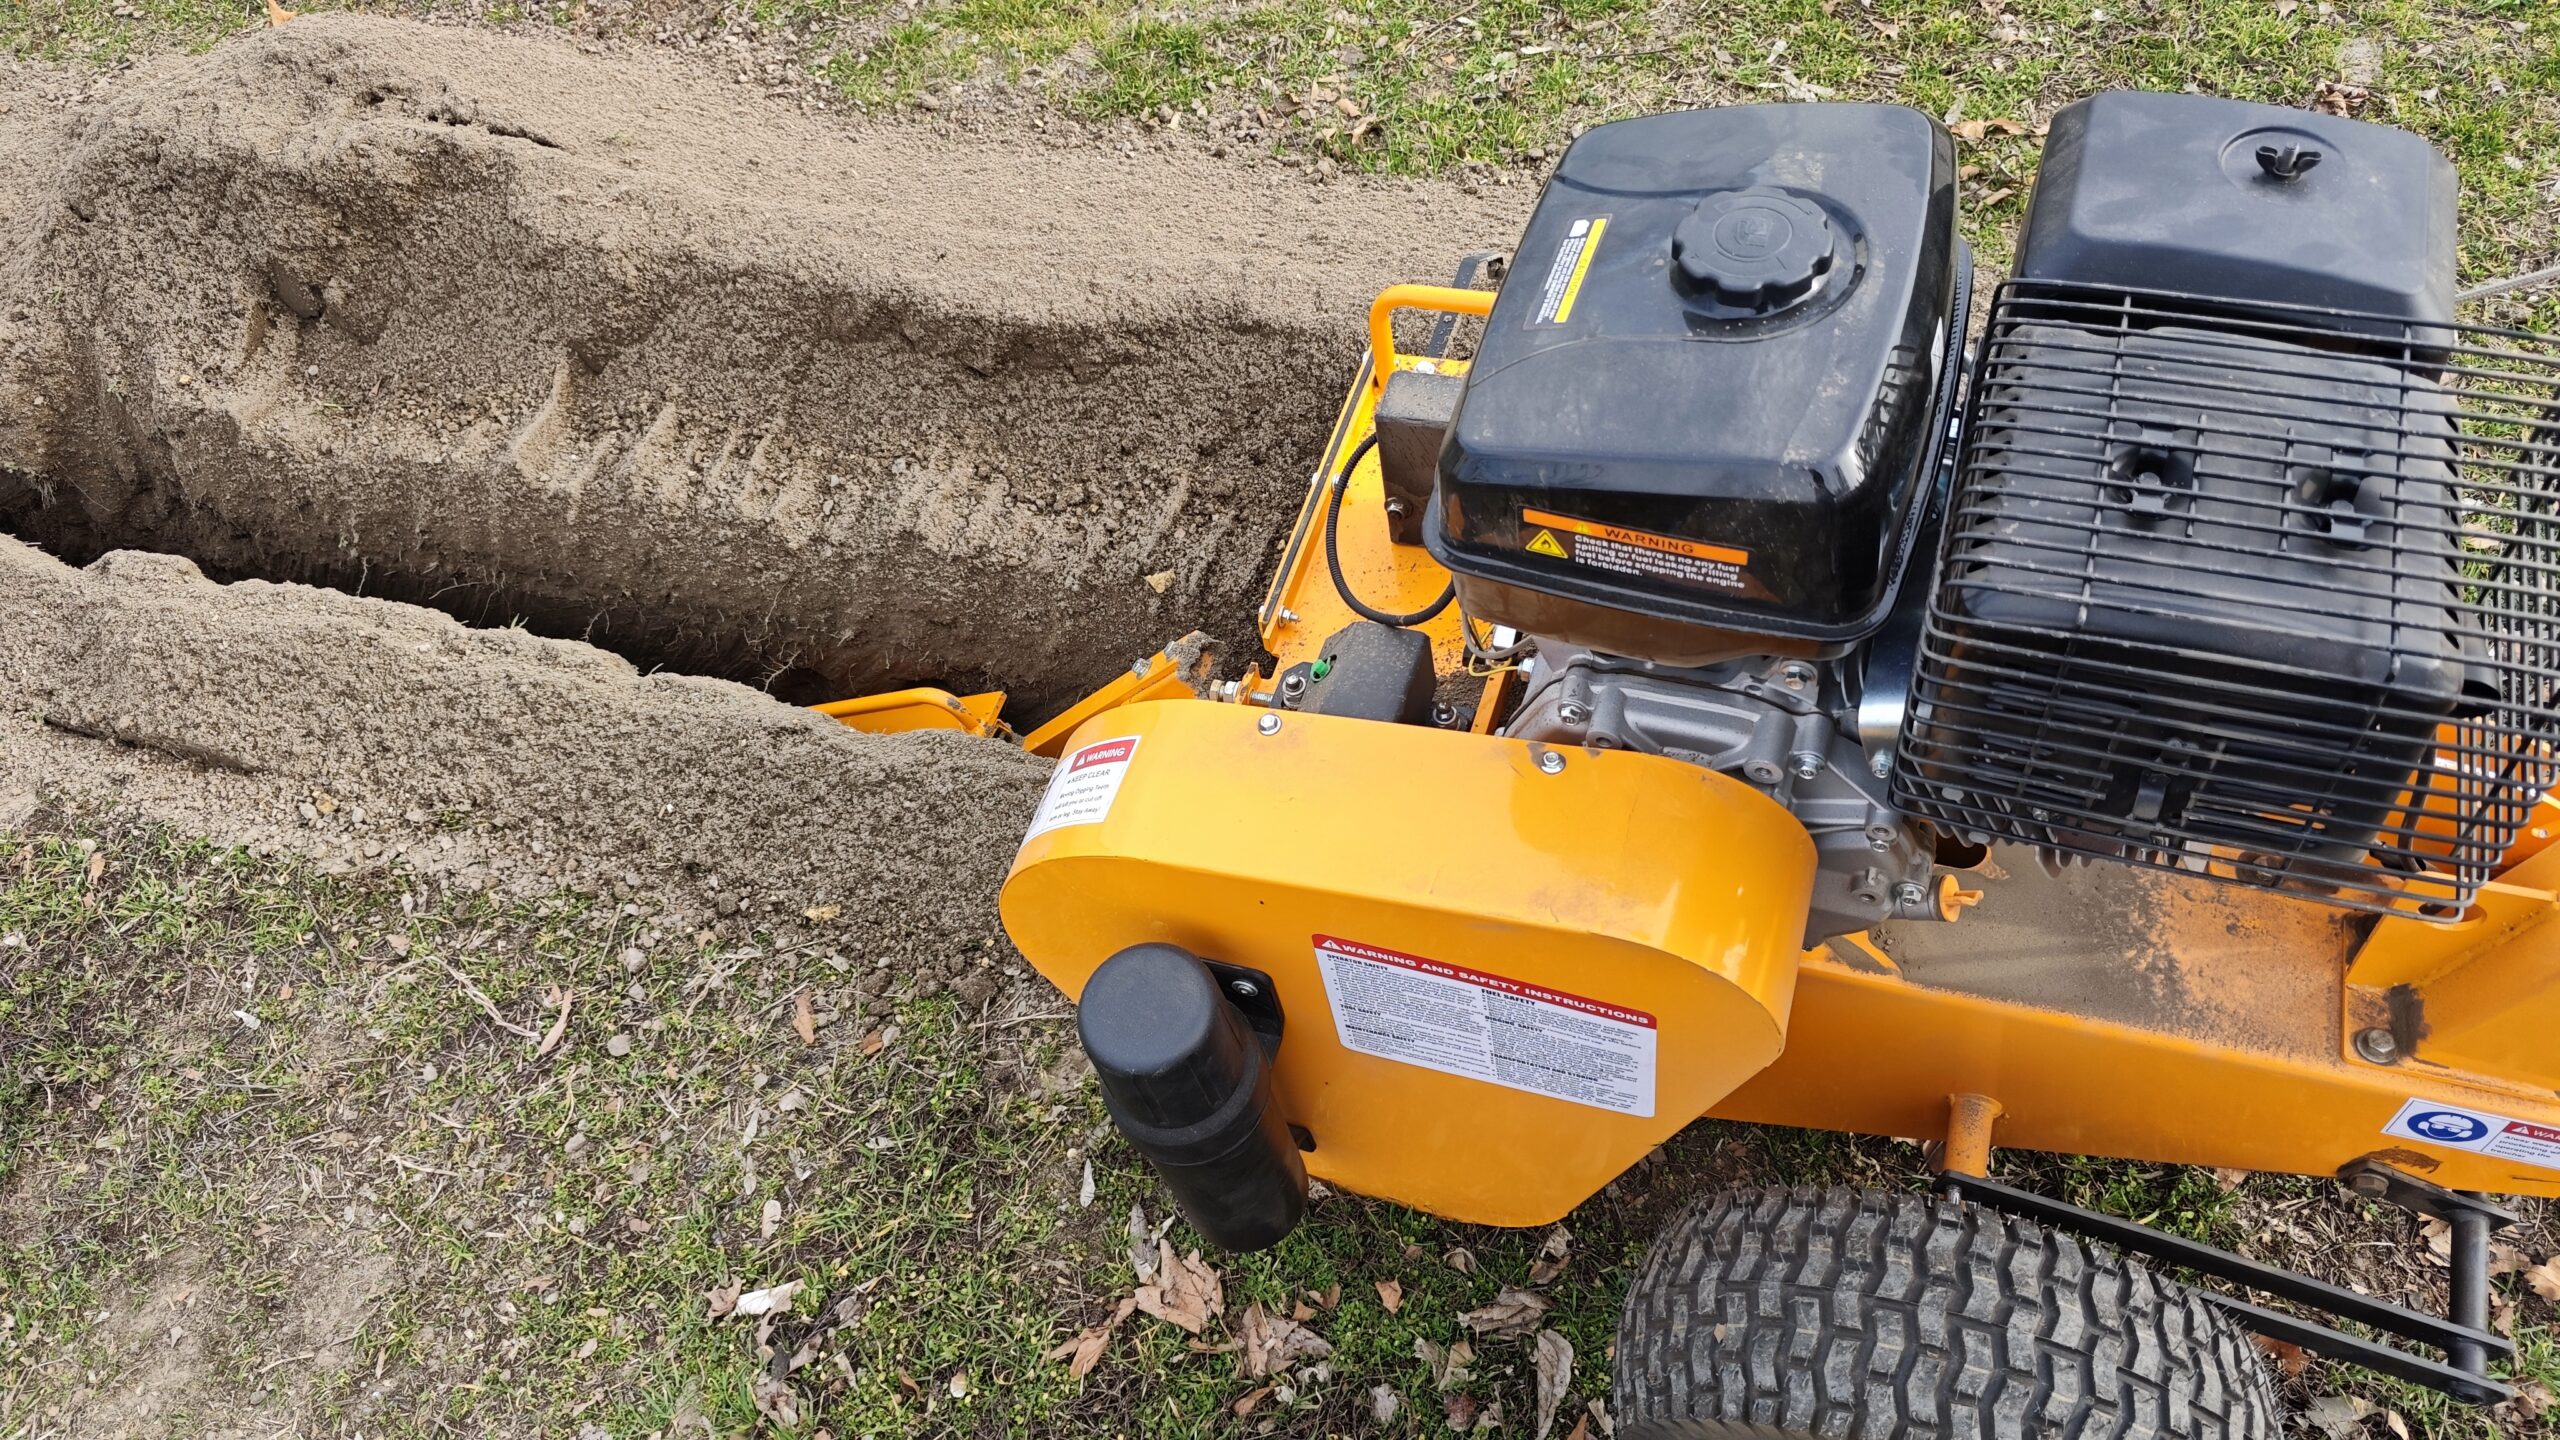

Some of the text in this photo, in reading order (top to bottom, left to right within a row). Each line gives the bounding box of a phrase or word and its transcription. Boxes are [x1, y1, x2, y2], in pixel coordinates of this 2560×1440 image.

[1604, 528, 1694, 554] WARNING
[1574, 542, 1616, 558] spilling
[1617, 551, 1630, 559] or
[1630, 553, 1653, 564] fuel
[1574, 534, 1740, 574] Check that there is no any fuel
[1574, 548, 1745, 589] fuel before stopping the engine
[1586, 559, 1644, 577] forbidden.
[1087, 748, 1125, 762] WARNING
[1071, 768, 1111, 784] KEEP CLEAR
[1326, 953, 1388, 971] OPERATOR SAFETY
[1341, 944, 1417, 968] WARNING
[1421, 963, 1454, 976] AND
[1458, 968, 1520, 992] SAFETY
[1525, 987, 1649, 1025] INSTRUCTIONS
[1481, 988, 1536, 1006] FUEL SAFETY
